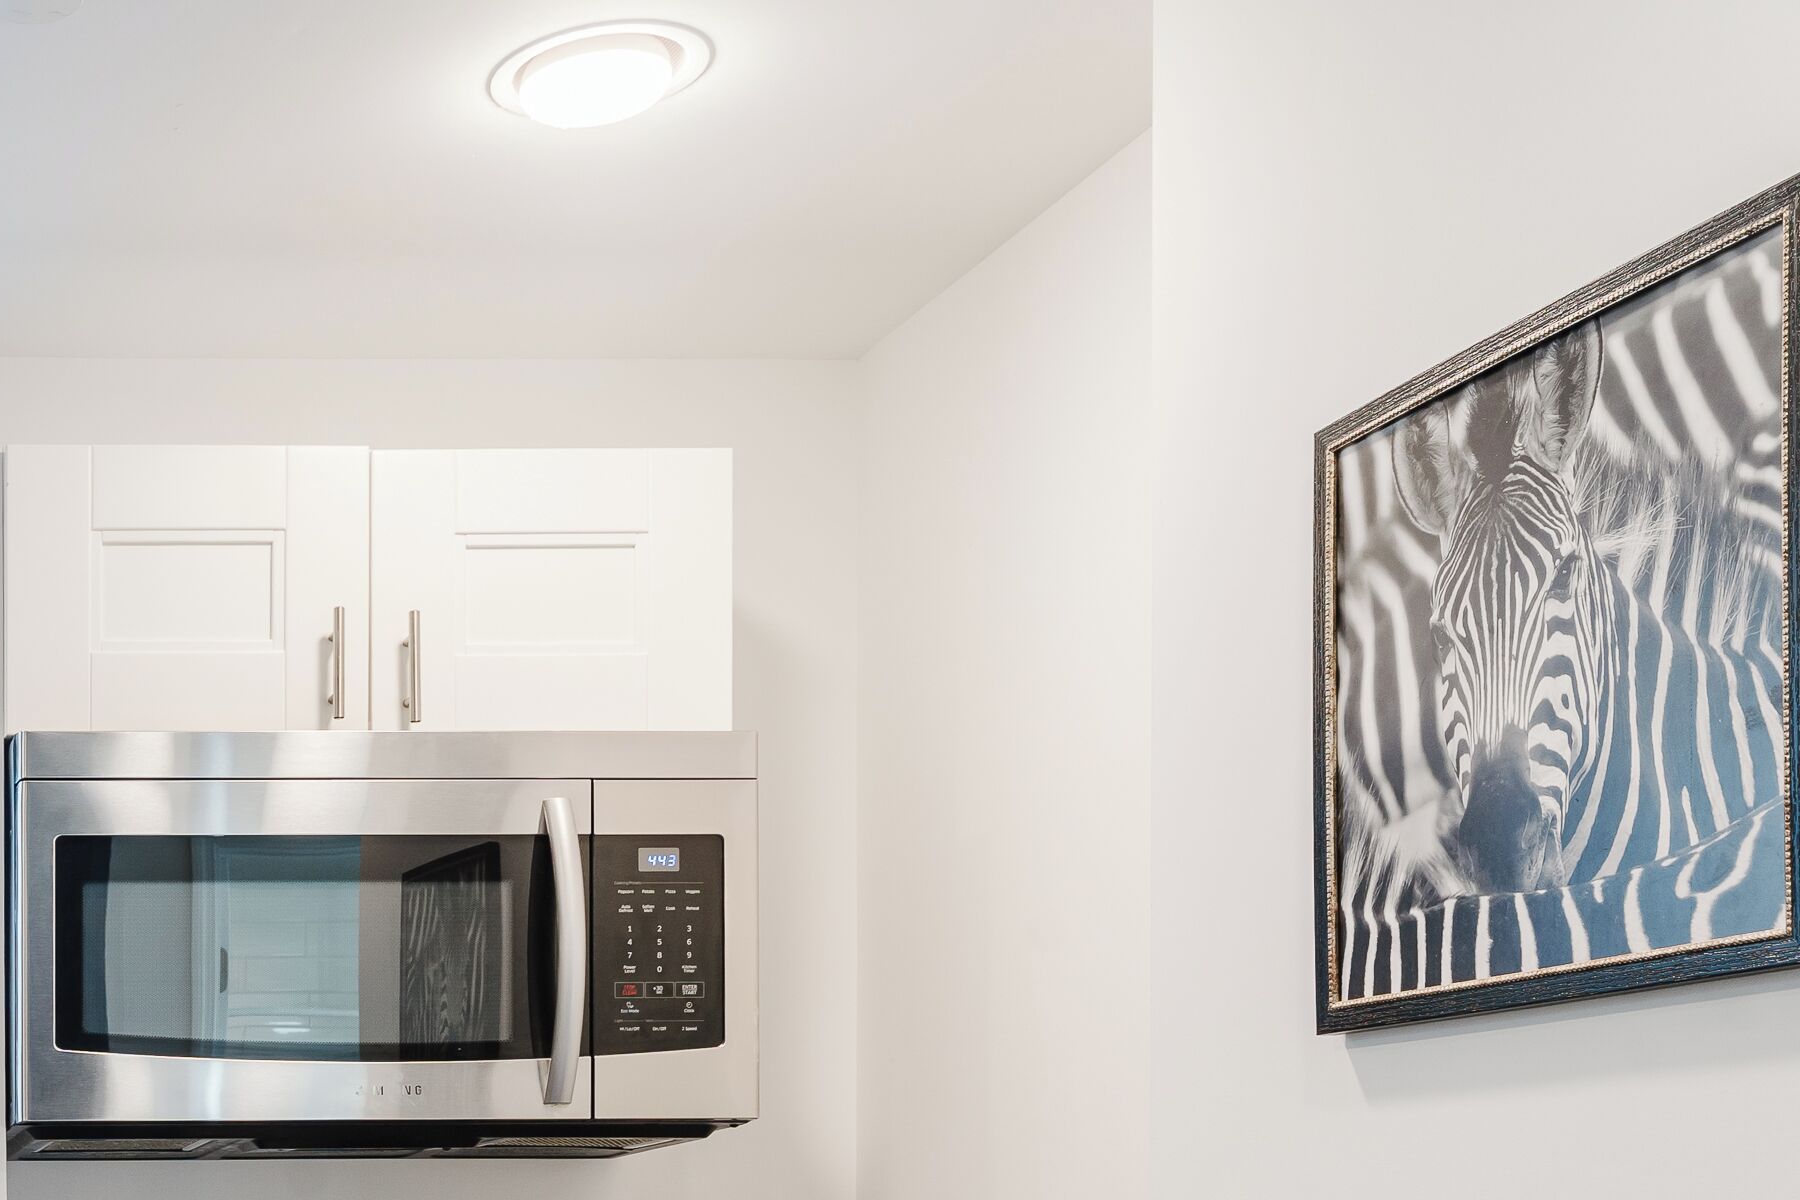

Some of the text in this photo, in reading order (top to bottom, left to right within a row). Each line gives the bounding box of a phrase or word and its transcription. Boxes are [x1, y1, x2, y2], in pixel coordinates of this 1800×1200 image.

[627, 925, 633, 933] 1
[656, 925, 663, 933] 2
[686, 925, 692, 933] 3
[627, 938, 633, 946] 4
[656, 938, 663, 946] 5
[686, 938, 692, 946] 6
[627, 951, 633, 959] 7
[656, 951, 663, 959] 8
[686, 951, 692, 959] 9
[656, 965, 663, 973] 0
